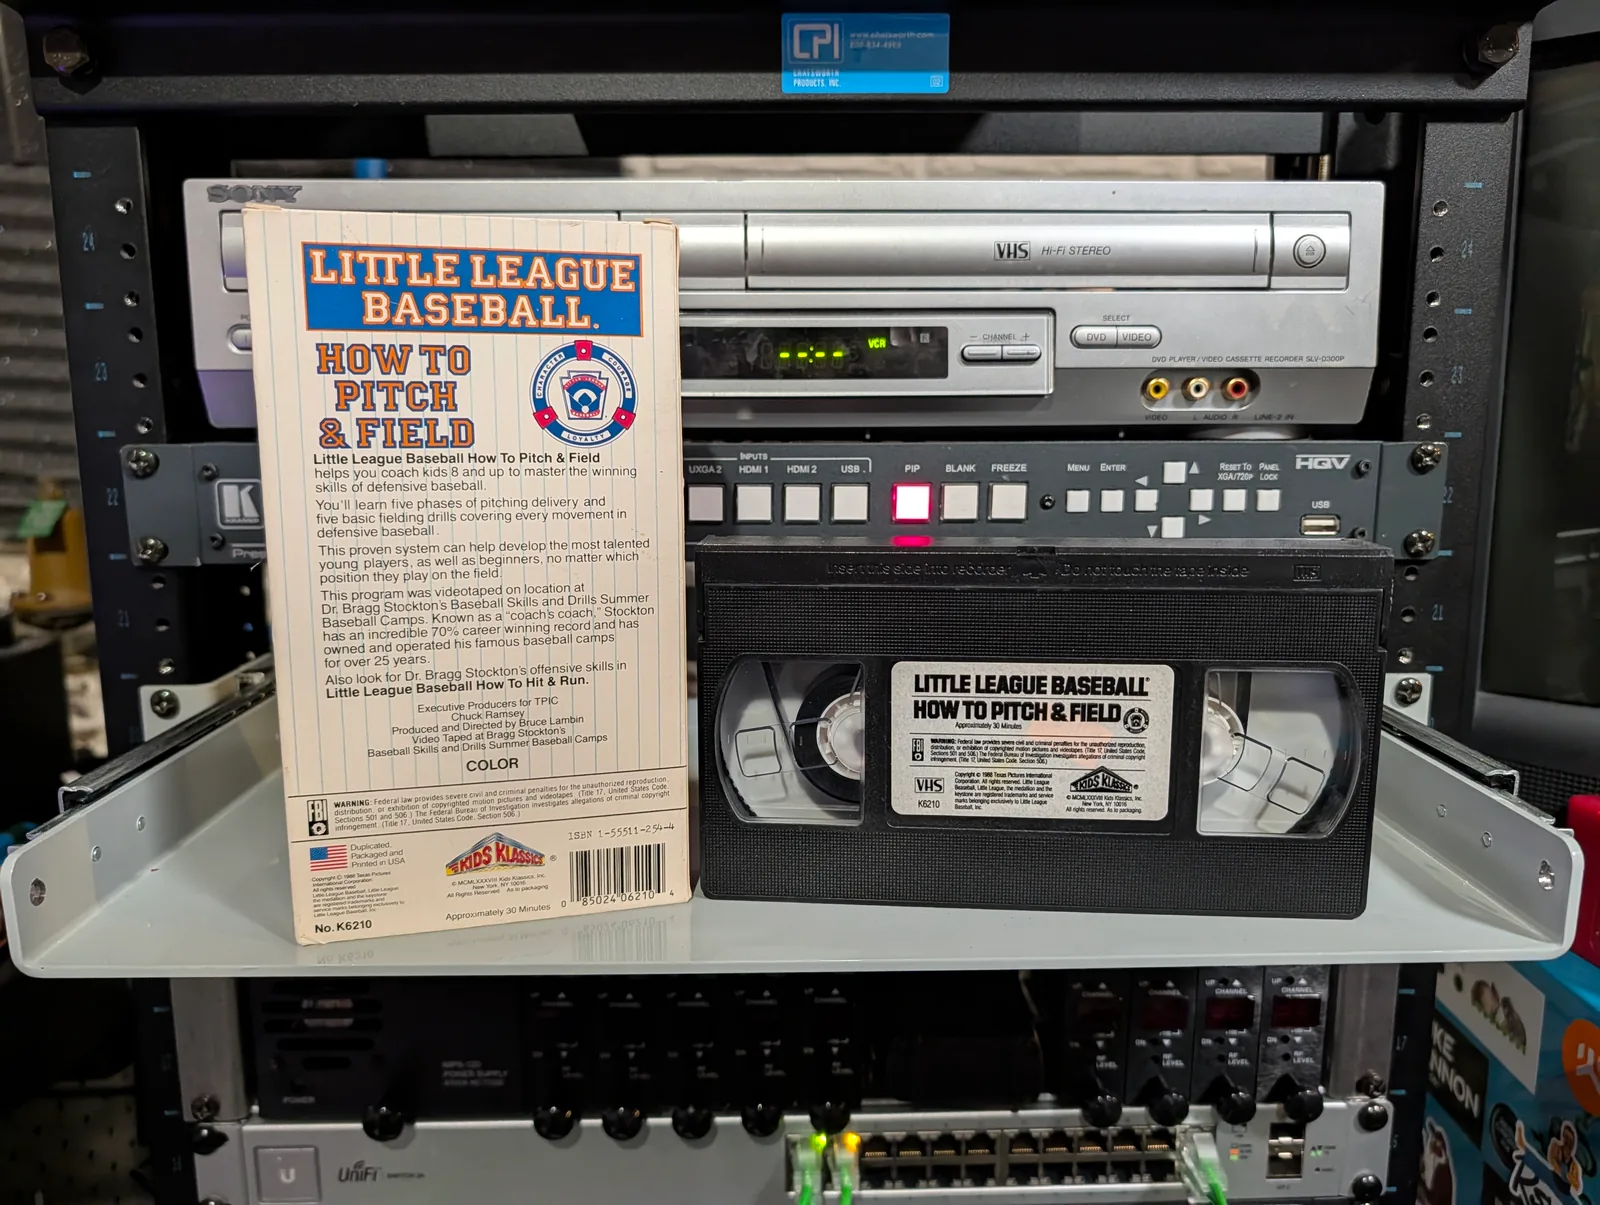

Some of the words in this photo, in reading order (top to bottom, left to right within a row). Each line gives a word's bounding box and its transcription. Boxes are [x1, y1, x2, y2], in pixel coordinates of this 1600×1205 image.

[793, 23, 840, 60] CPI
[206, 184, 302, 203] SONY
[994, 241, 1030, 261] VHS
[1041, 246, 1066, 256] Hi-Fi
[1068, 246, 1112, 256] STEREO
[310, 249, 461, 287] LITTLE
[470, 254, 636, 292] LEAGUE
[1102, 314, 1131, 322] SELECT
[868, 337, 887, 349] VCR
[983, 333, 1017, 341] CHANNEL
[1086, 333, 1107, 342] DVD
[1122, 333, 1153, 342] VIDEO
[316, 343, 413, 375] HOW
[418, 345, 471, 375] TO
[1151, 355, 1167, 363] DVD
[1169, 355, 1196, 363] PLAYER
[1202, 355, 1224, 363] VIDEO
[1225, 355, 1263, 363] CASSETTE
[1264, 355, 1304, 363] RECORDER
[536, 353, 565, 398] CHARACTER
[608, 357, 632, 392] COURAGE
[334, 380, 458, 412] PITCH
[319, 418, 352, 449] &
[356, 418, 475, 449] FIELD
[313, 453, 348, 465] Little
[351, 453, 402, 467] League
[406, 452, 464, 464] Baseball
[467, 452, 497, 463] How
[499, 452, 515, 464] To
[519, 452, 552, 463] Pitch
[556, 452, 565, 463] &
[569, 452, 600, 463] Field
[739, 452, 768, 461] INPUTS
[1295, 454, 1351, 470] HQV
[314, 467, 350, 482] helps
[353, 469, 377, 482] you
[381, 467, 419, 478] coach
[422, 466, 448, 477] kids
[450, 466, 459, 477] 8
[462, 466, 485, 477] and
[489, 468, 504, 479] up
[508, 466, 520, 477] to
[524, 466, 566, 476] master
[568, 466, 588, 476] the
[591, 467, 637, 479] winning
[689, 466, 713, 474] UXGA
[739, 466, 762, 474] HDMI
[787, 466, 809, 474] HDMI
[905, 464, 921, 473] PIP
[945, 464, 976, 473] BLANK
[991, 463, 1027, 472] FREEZE
[315, 481, 347, 493] skills
[351, 481, 363, 492] of
[366, 481, 427, 492] defensive
[430, 480, 486, 491] baseball.
[315, 499, 350, 511] You'll
[355, 499, 387, 510] learn
[391, 498, 413, 509] five
[417, 498, 462, 513] phases
[465, 497, 477, 508] of
[480, 497, 528, 510] pitching
[531, 496, 578, 509] delivery
[583, 496, 606, 506] and
[1311, 500, 1330, 509] USB
[316, 513, 338, 524] five
[342, 513, 375, 524] basic
[378, 512, 424, 528] fielding
[427, 511, 457, 522] drills
[459, 512, 512, 523] covering
[515, 512, 548, 523] every
[552, 510, 614, 520] movement
[617, 508, 627, 518] in
[316, 527, 378, 538] defensive
[381, 525, 439, 536] baseball.
[326, 687, 360, 699] Little
[363, 686, 413, 698] League
[416, 679, 472, 693] Baseball
[476, 680, 504, 690] How
[507, 678, 523, 688] To
[526, 676, 544, 687] Hit
[547, 676, 556, 687] &
[560, 675, 589, 685] Run.
[914, 674, 971, 693] LITTLE
[975, 674, 1047, 694] LEAGUE
[1051, 676, 1149, 696] BASEBALL
[913, 700, 960, 719] HOW
[962, 700, 988, 720] TO
[991, 701, 1048, 721] PITCH
[1050, 702, 1068, 722] &
[1070, 702, 1121, 722] FIELD
[955, 721, 992, 730] Approximately
[1001, 722, 1022, 730] Minutes
[466, 757, 519, 772] COLOR
[917, 779, 943, 792] VHS
[1079, 776, 1100, 790] KIDS
[918, 800, 940, 808] K6210
[568, 831, 592, 840] ISBN
[598, 822, 675, 838] 1-55511-254-4
[351, 851, 388, 861] Packaged
[351, 860, 378, 868] Printed
[387, 857, 406, 865] USA
[459, 845, 492, 873] KIDS
[495, 841, 544, 865] KLASSICS
[561, 900, 567, 908] 0
[582, 895, 616, 907] 85024
[621, 890, 655, 902] 06210
[669, 889, 675, 897] 4
[446, 908, 505, 921] Approximately
[506, 906, 517, 915] 30
[518, 903, 551, 913] Minutes
[315, 924, 335, 934] No.
[336, 919, 373, 932] K6210
